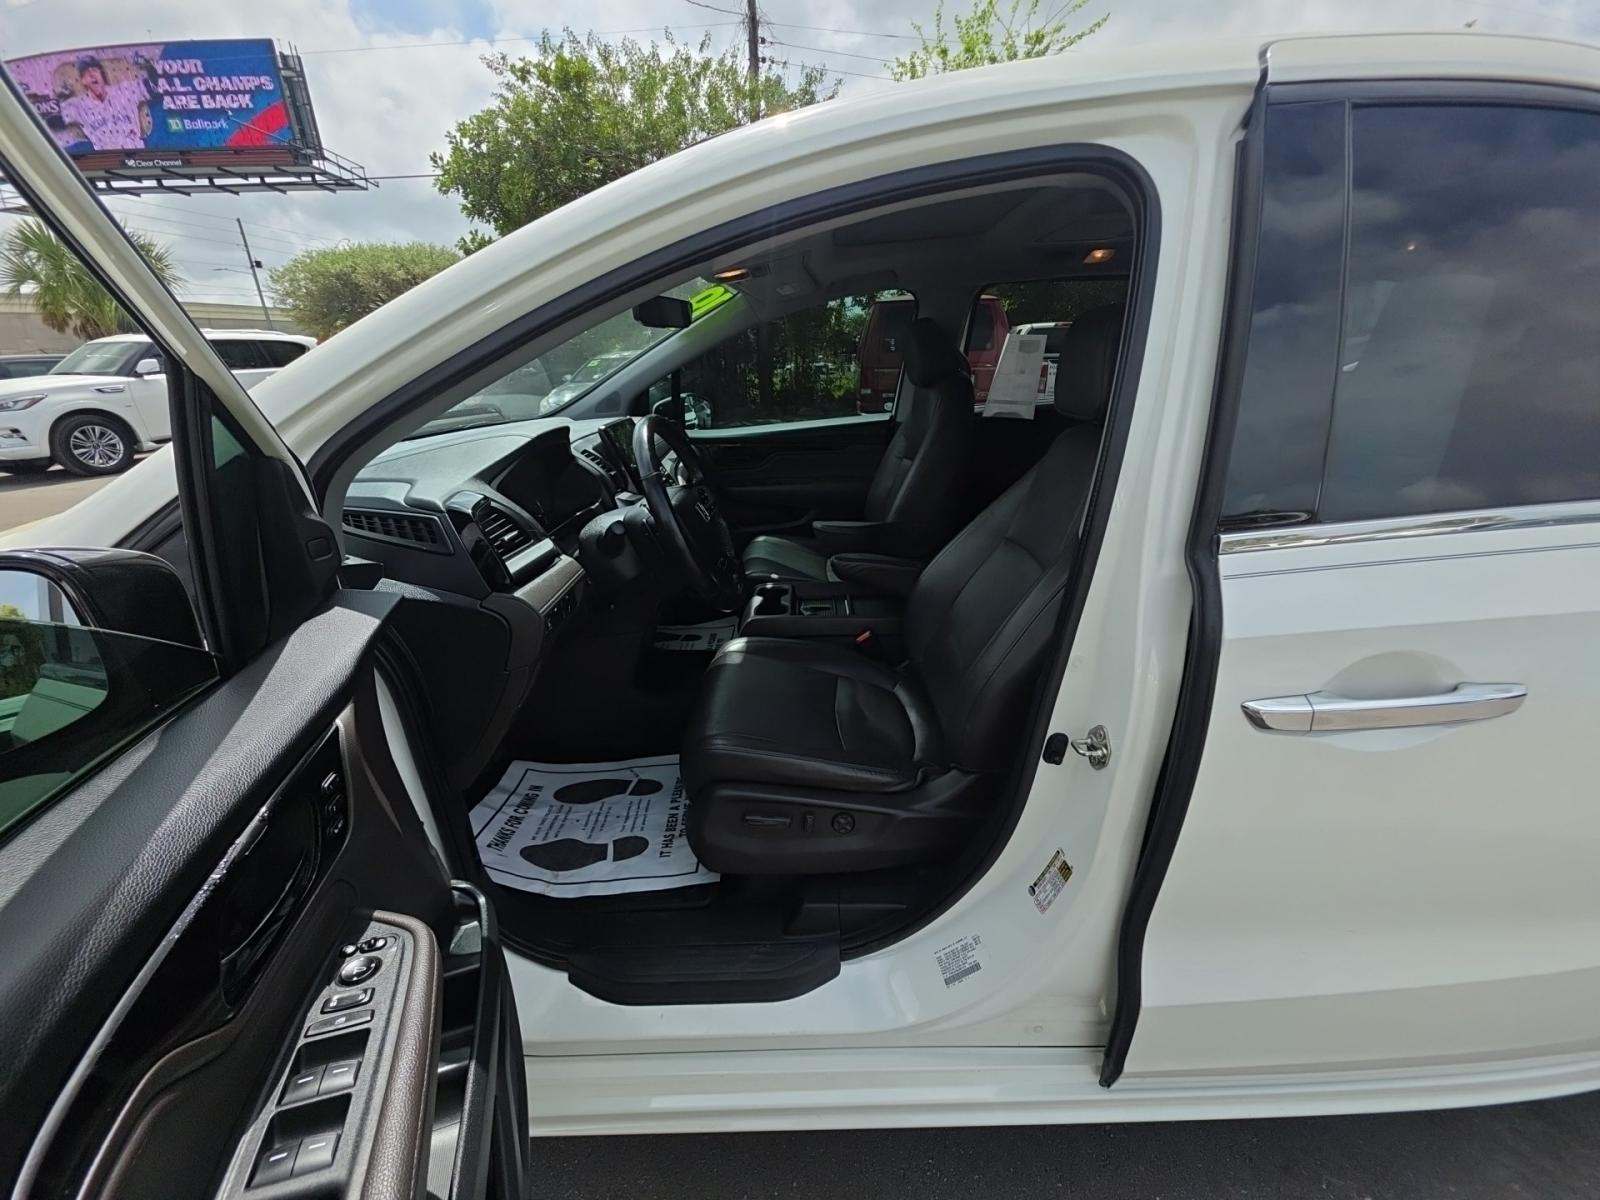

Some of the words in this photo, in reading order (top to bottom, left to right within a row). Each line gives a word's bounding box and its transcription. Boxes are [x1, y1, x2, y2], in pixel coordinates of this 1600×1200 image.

[151, 59, 204, 74] YOUR
[156, 77, 192, 92] A.L.
[193, 75, 274, 91] CHAMPS
[163, 95, 201, 110] ARE
[201, 94, 254, 109] BACK
[183, 119, 229, 130] Ballpark
[154, 159, 181, 167] Channel
[528, 784, 544, 792] IN
[513, 793, 540, 815] COMING
[504, 815, 526, 829] FOR
[665, 813, 679, 832] BEEN
[486, 827, 516, 853] THANKS
[661, 833, 675, 849] HAS
